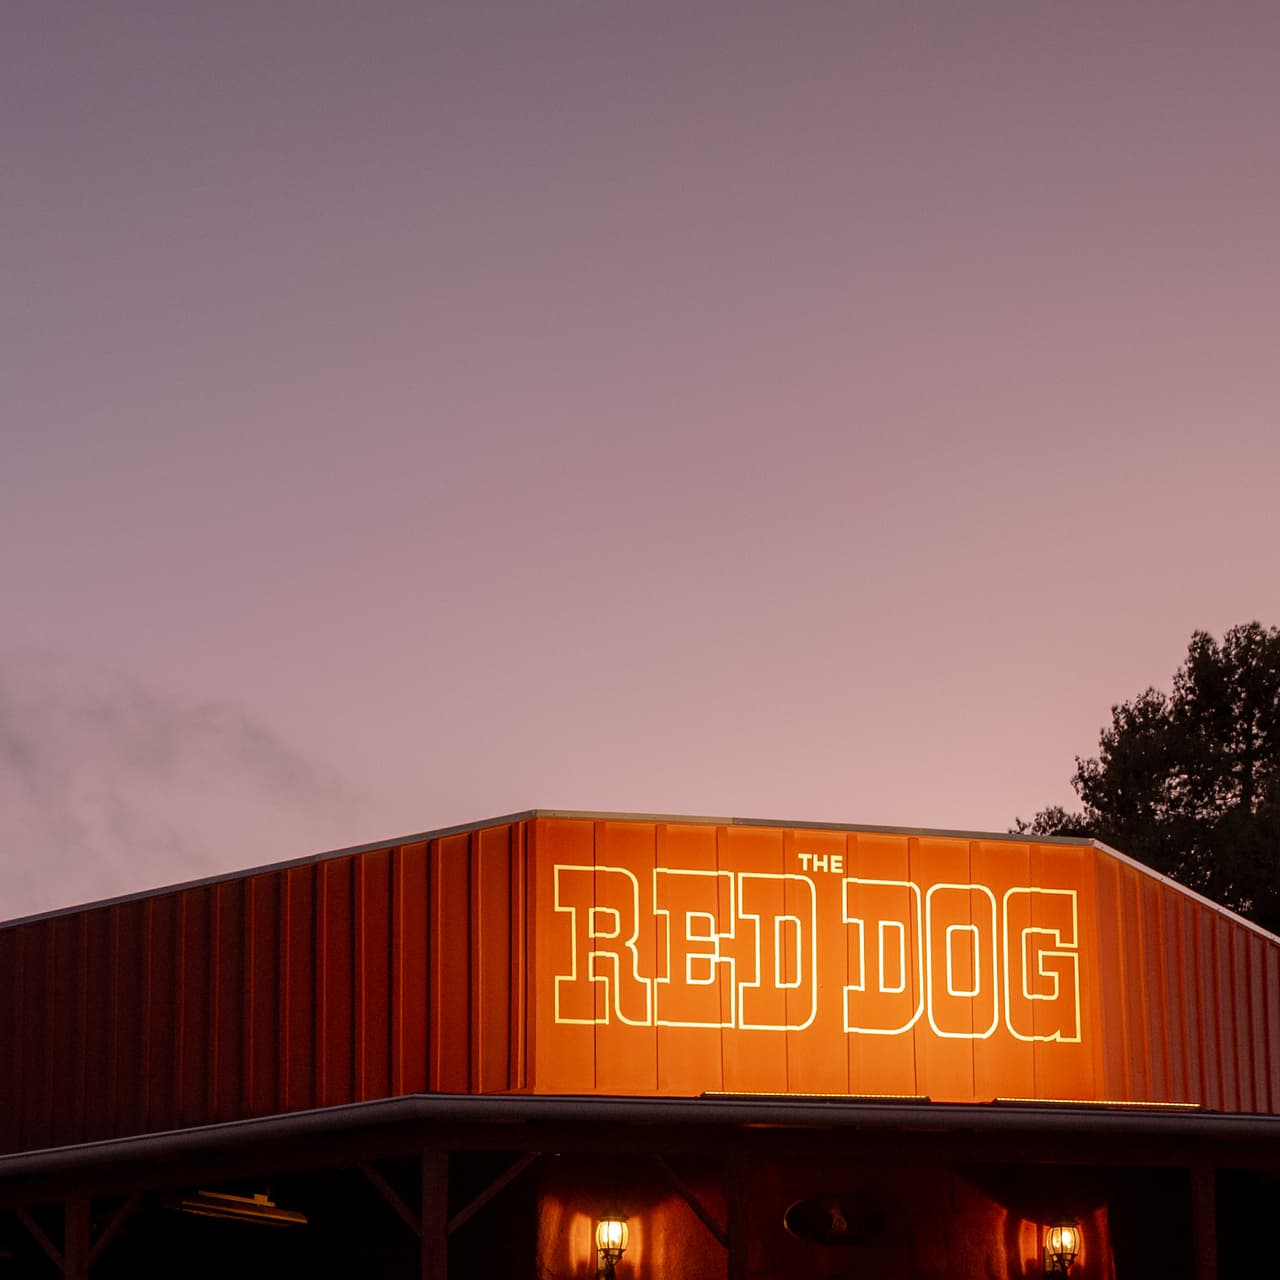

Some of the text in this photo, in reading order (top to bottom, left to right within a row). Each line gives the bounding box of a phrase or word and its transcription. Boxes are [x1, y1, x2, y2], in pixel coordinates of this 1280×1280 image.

[797, 853, 844, 874] THE
[553, 864, 1082, 1043] RED DOG
